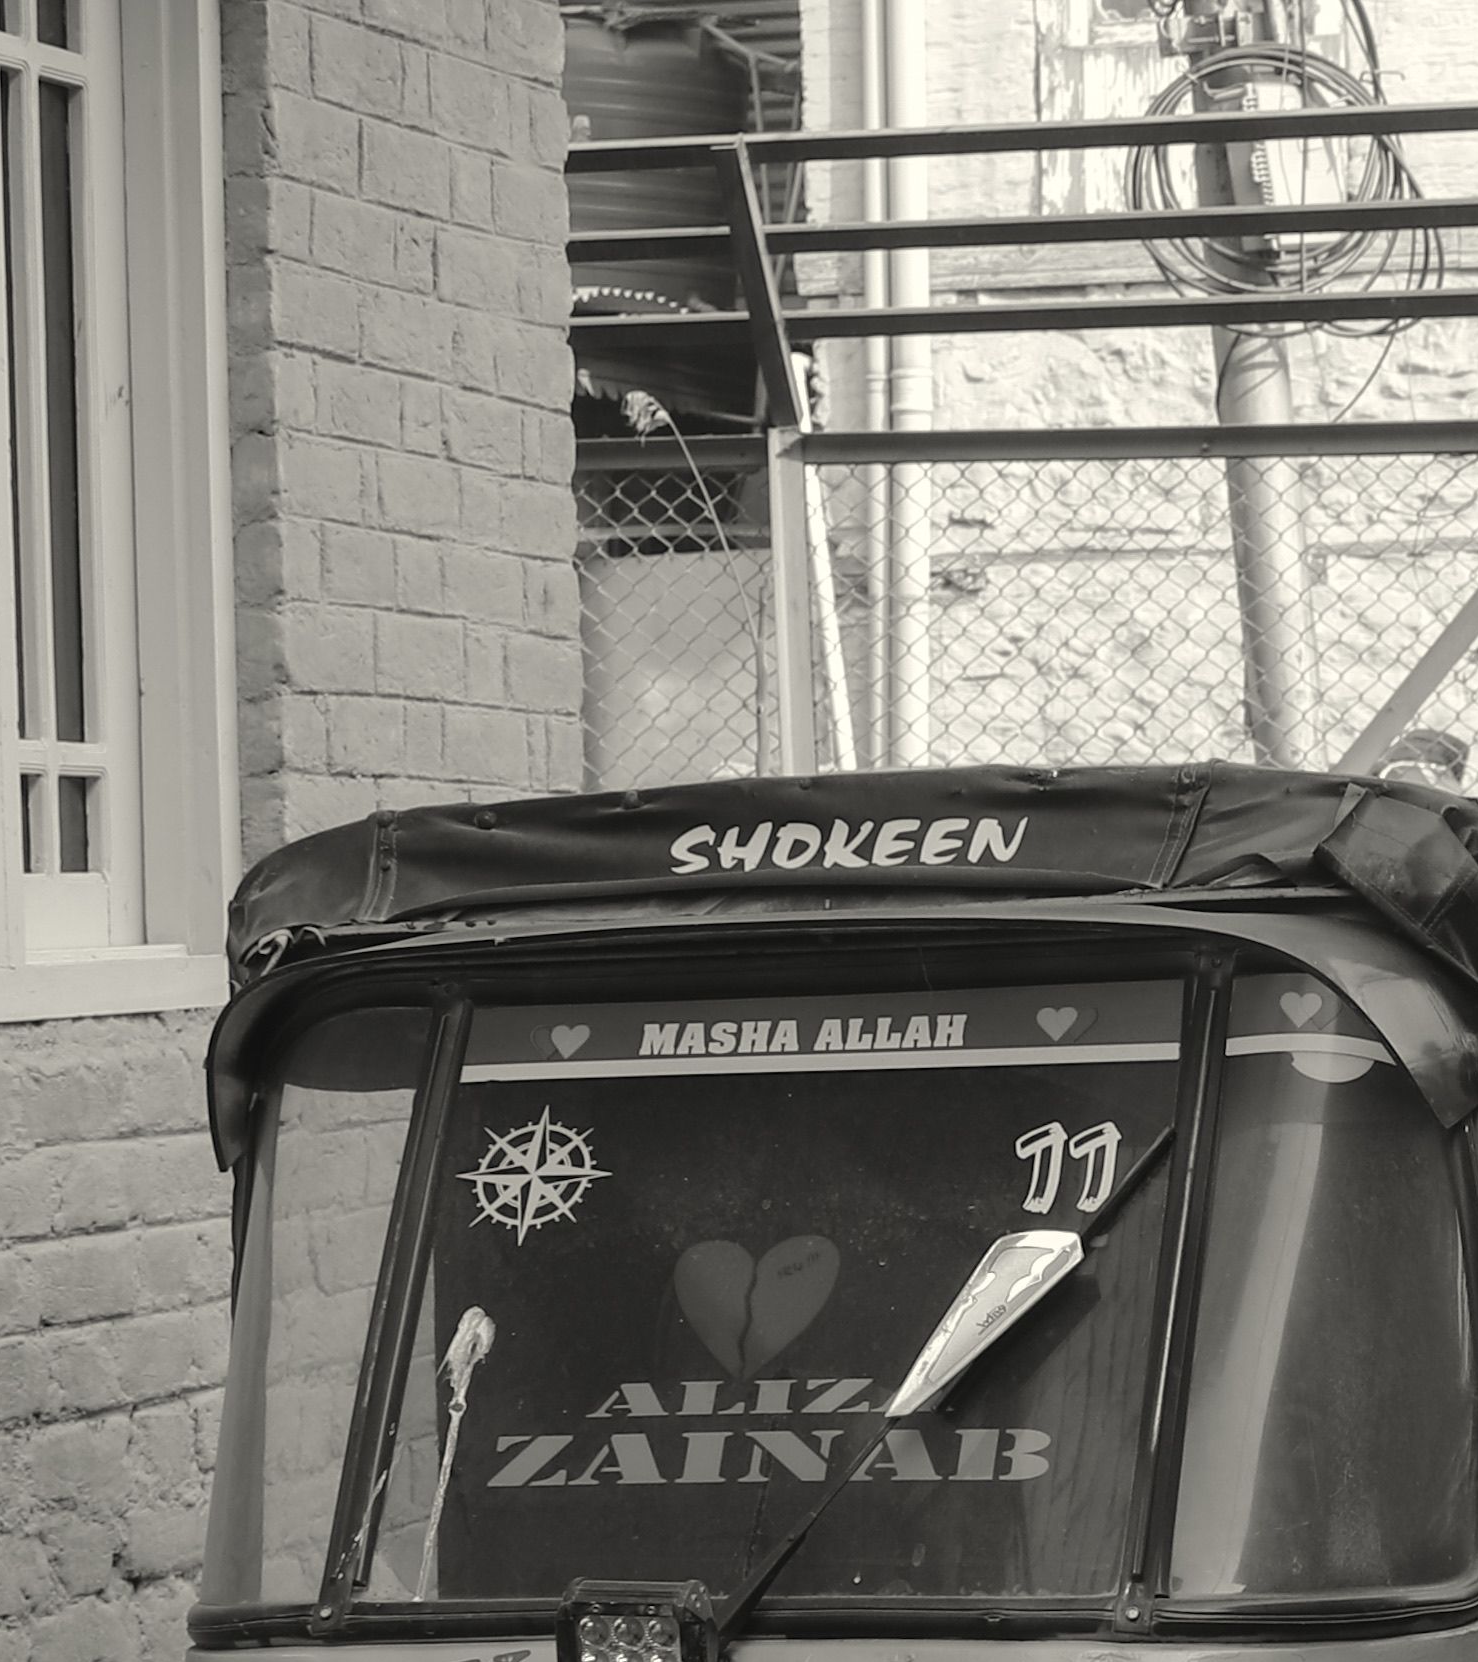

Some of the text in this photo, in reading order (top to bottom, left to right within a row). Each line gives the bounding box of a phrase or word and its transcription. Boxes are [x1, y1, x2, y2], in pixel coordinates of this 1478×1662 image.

[669, 816, 1029, 875] SHOKEEN
[638, 1013, 968, 1056] MASHA ALLAH
[585, 1378, 953, 1419] ALIZ
[487, 1429, 1052, 1487] ZAINAB
